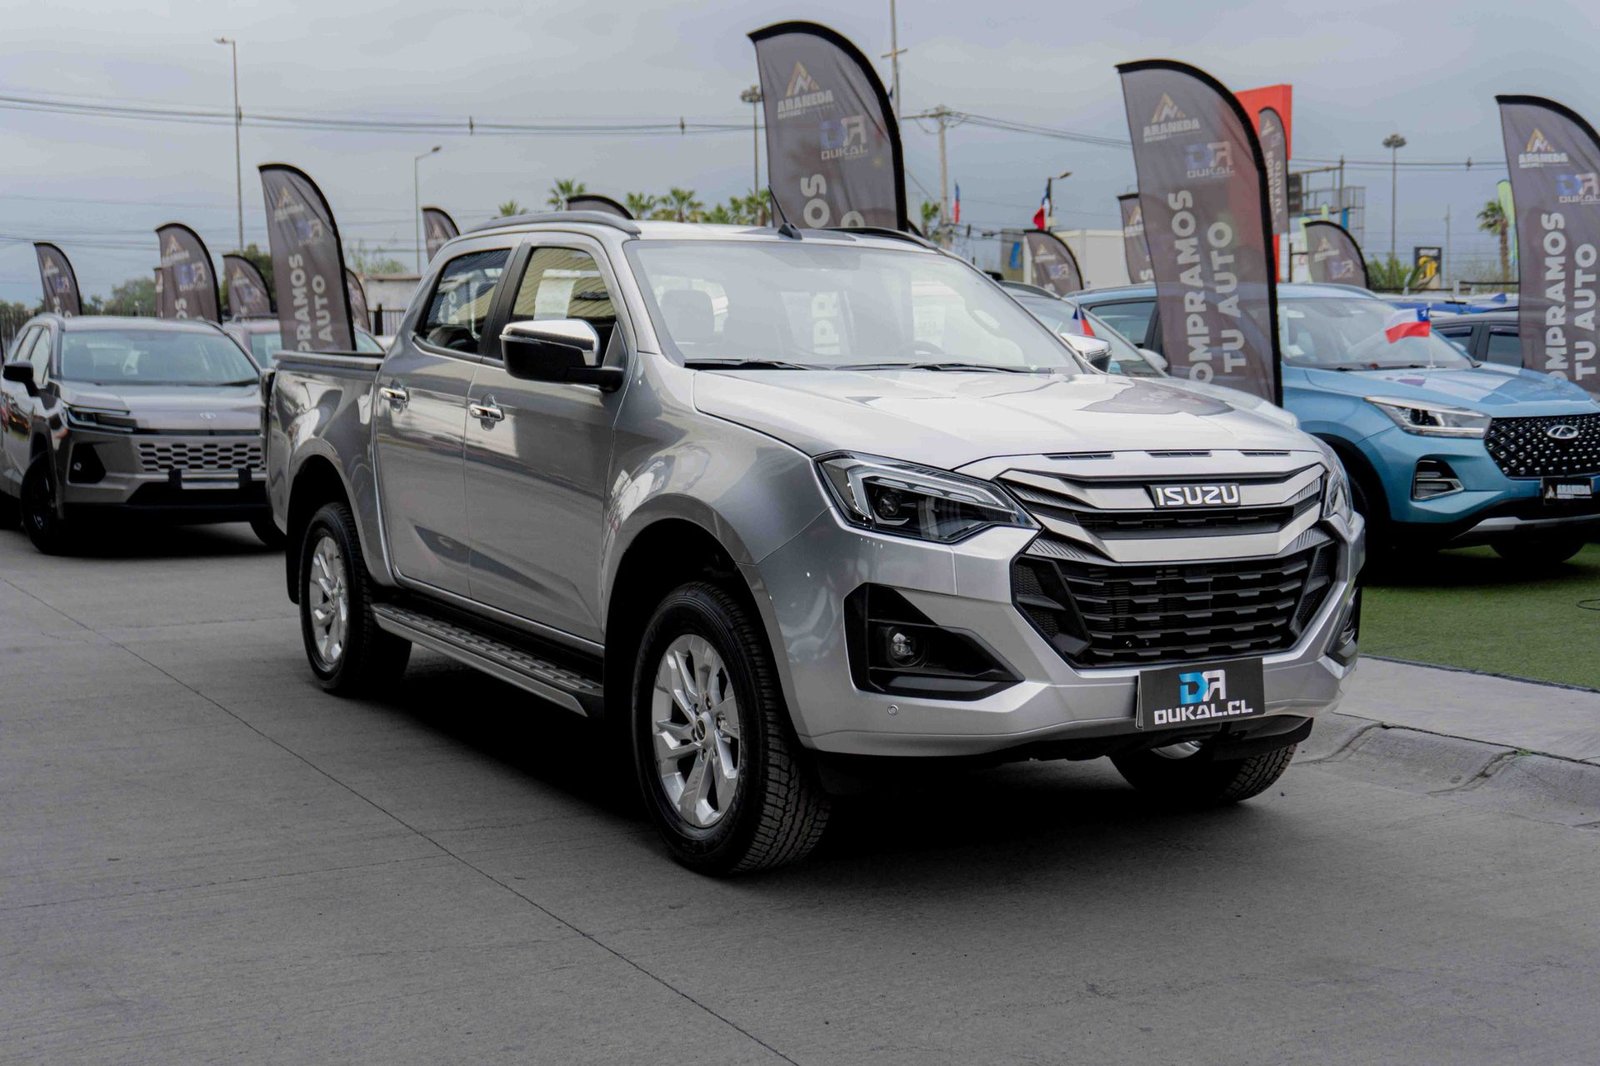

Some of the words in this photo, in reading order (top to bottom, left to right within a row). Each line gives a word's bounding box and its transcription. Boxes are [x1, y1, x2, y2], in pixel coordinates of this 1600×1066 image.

[1207, 221, 1242, 318] AUTO
[1574, 243, 1598, 332] AUTO
[312, 275, 334, 342] AUTO
[1221, 329, 1247, 373] TU
[1575, 340, 1597, 381] TU
[1155, 485, 1239, 506] ISUZU
[1153, 699, 1253, 725] DUKAL.CL
